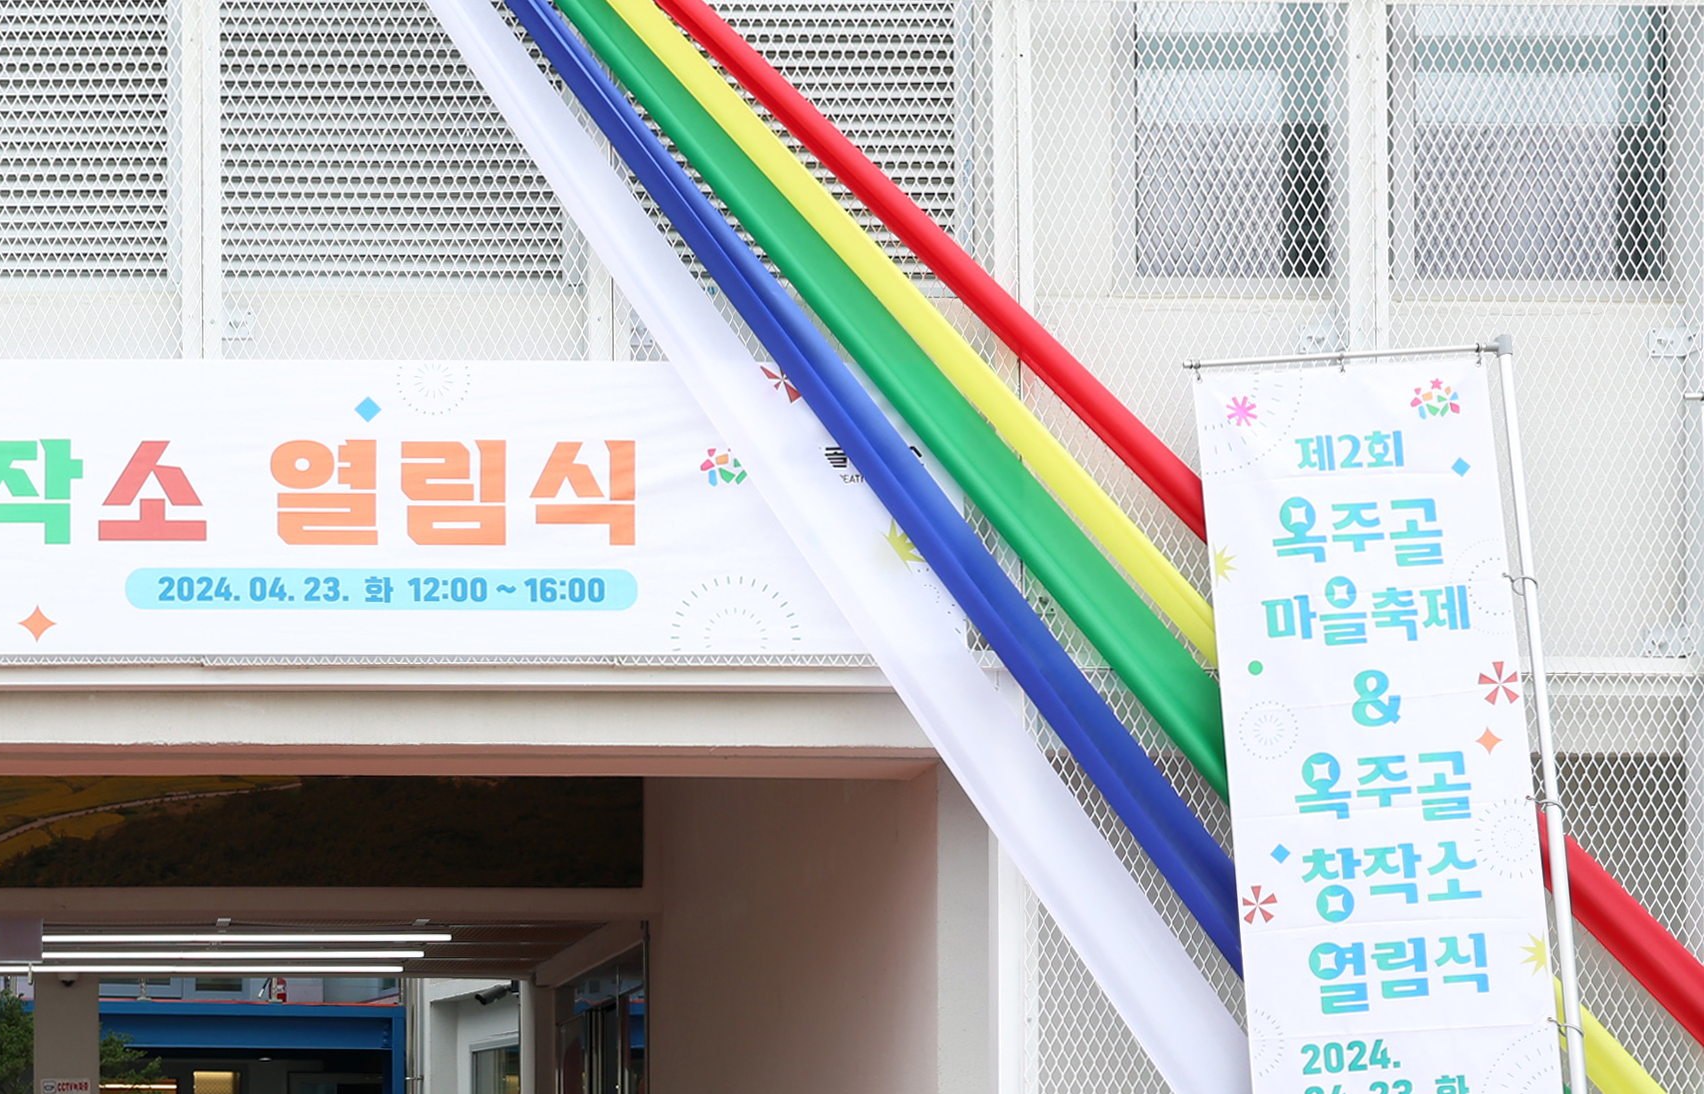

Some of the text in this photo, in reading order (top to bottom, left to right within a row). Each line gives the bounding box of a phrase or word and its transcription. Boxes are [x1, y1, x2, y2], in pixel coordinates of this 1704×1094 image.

[1295, 431, 1405, 471] 제2회
[270, 438, 636, 546] 열림식
[1272, 497, 1444, 567] 옥주골
[157, 576, 241, 603] 2024.
[249, 576, 294, 603] 04.
[303, 576, 348, 603] 23.
[364, 575, 394, 604] 화
[407, 576, 487, 603] 12:00
[524, 576, 606, 603] 16:00
[1262, 576, 1470, 646] 마을축제
[1351, 669, 1401, 727] &
[1295, 751, 1471, 821] 옥주골
[1301, 841, 1482, 923] 창작소
[1308, 932, 1490, 1015] 열림식
[1300, 1039, 1401, 1075] 2024.
